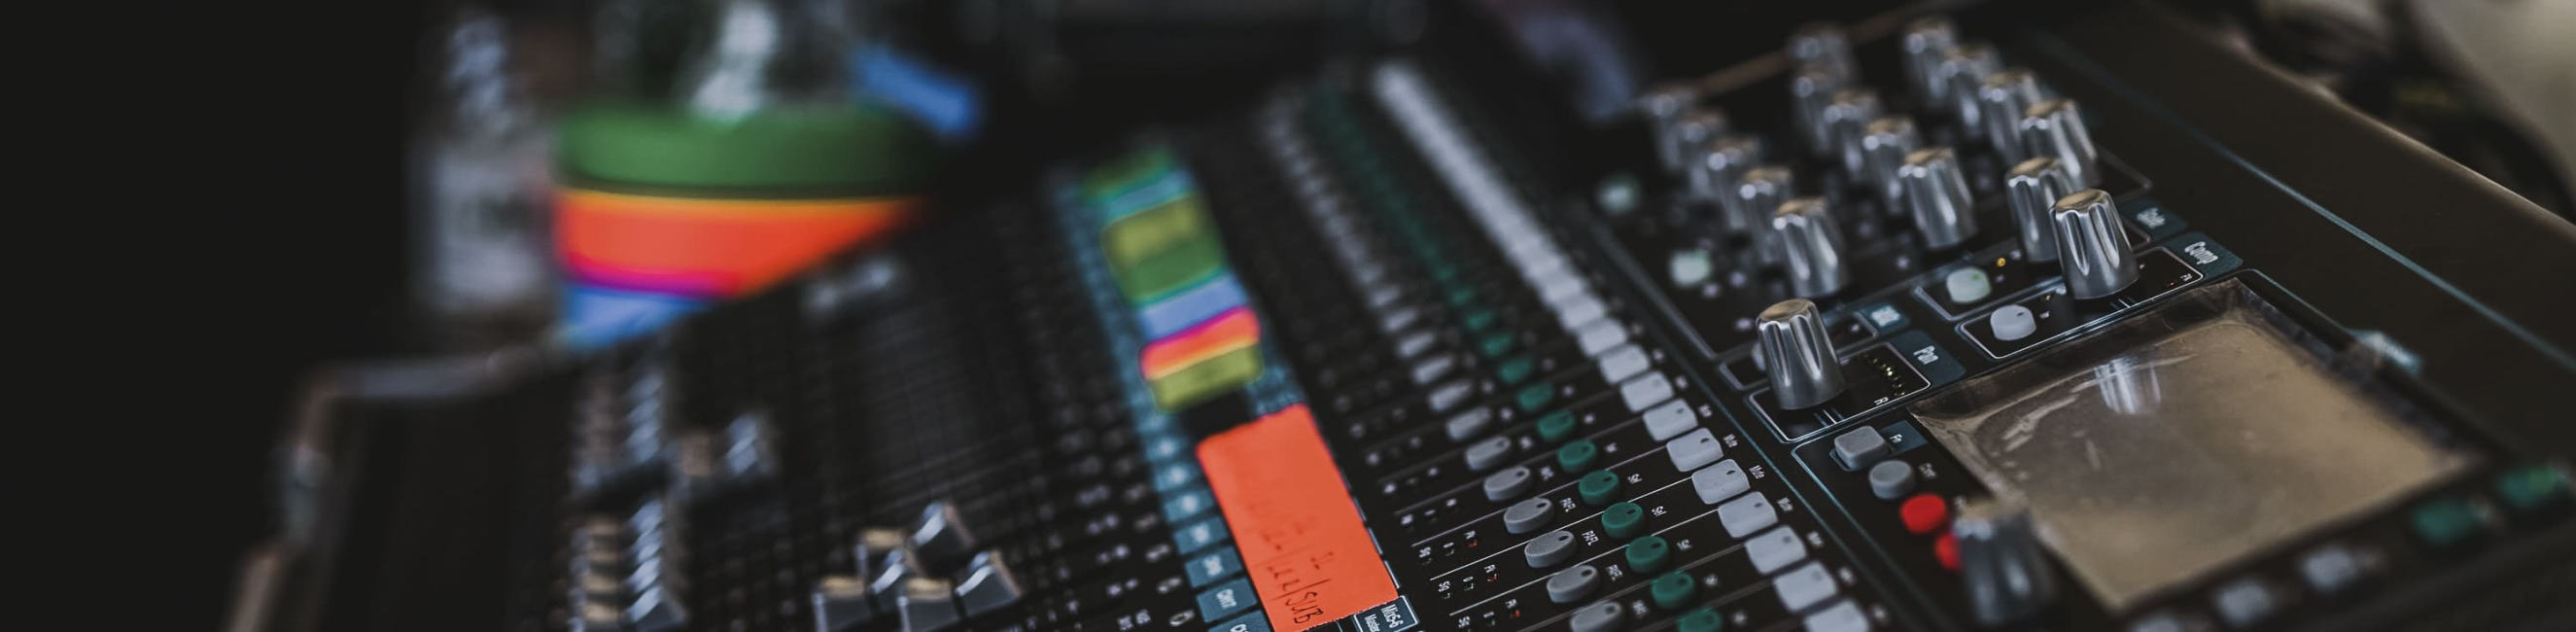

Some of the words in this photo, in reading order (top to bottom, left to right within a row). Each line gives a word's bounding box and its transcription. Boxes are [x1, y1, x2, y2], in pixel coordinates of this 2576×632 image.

[2184, 241, 2218, 264] Comp
[1913, 345, 1939, 365] Pan
[1874, 397, 1889, 405] R
[1749, 465, 1765, 479] Mute
[1560, 497, 1577, 513] PAFL
[1652, 506, 1667, 517] Sel
[1582, 530, 1599, 546] PAFL
[1285, 591, 1324, 624] SUB
[1380, 604, 1405, 628] Mix5-6
[1364, 614, 1380, 632] Master
